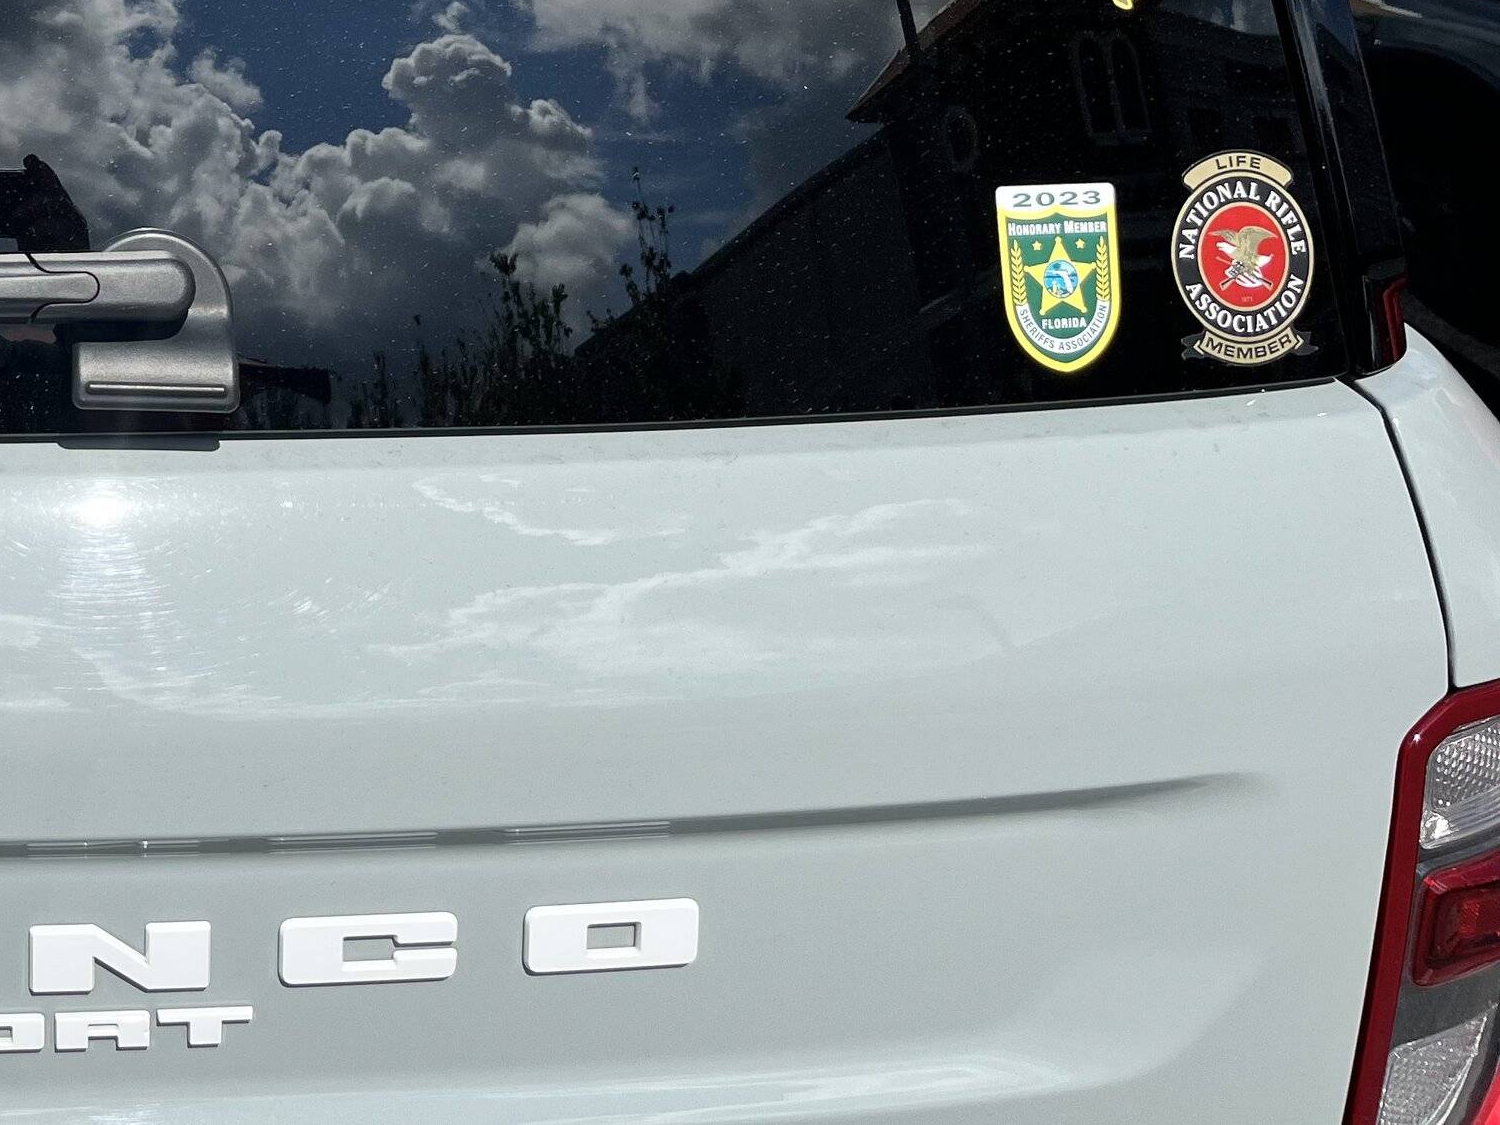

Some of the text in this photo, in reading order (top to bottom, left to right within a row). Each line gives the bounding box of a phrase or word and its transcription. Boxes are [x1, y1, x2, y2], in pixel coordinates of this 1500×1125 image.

[1214, 155, 1262, 170] LIFE
[1012, 190, 1101, 208] 2023
[1179, 181, 1306, 260] NATIONAL RIFLE
[1186, 274, 1304, 333] ASSOCIATION
[1019, 304, 1108, 351] SHERIFFS ASSOCIATION
[1041, 316, 1088, 329] FLORIDA
[1206, 336, 1292, 359] MEMBER
